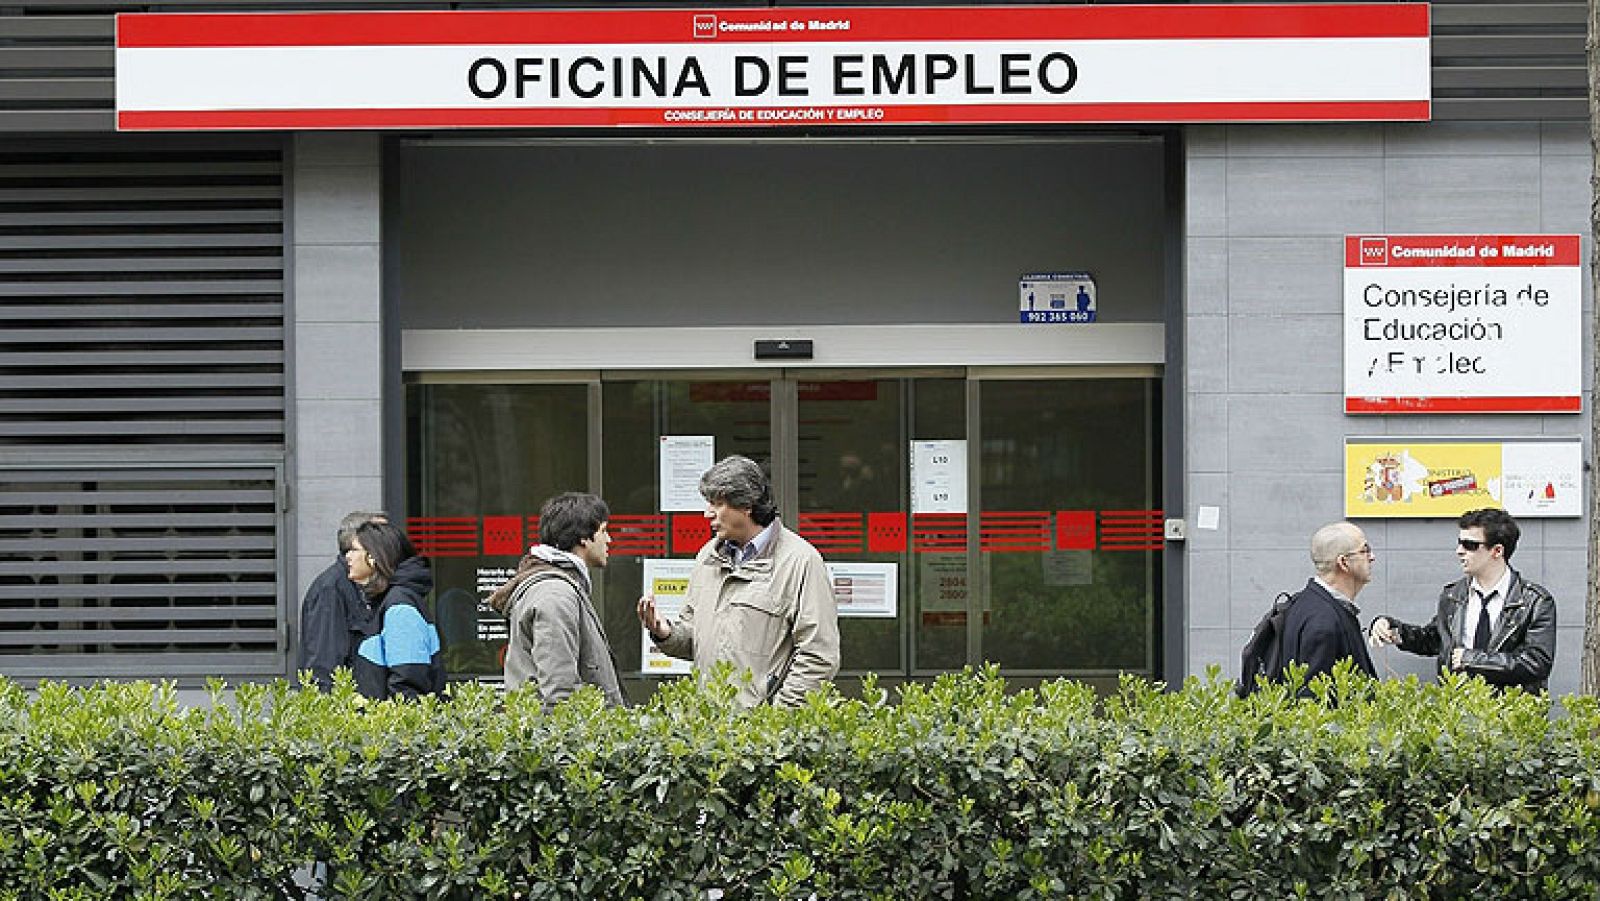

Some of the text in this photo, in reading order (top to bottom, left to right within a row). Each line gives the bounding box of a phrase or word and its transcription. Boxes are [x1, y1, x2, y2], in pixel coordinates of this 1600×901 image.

[719, 20, 850, 32] Comunidad de Madrid
[467, 52, 1078, 99] OFICINA DE EMPLEO
[664, 107, 884, 122] CONSEJERÍA DE EDUCACIÓN Y EMPLEO
[1391, 244, 1555, 258] Comunidad de Madrid
[1363, 283, 1507, 313] Consejería
[1363, 317, 1503, 342] Educación
